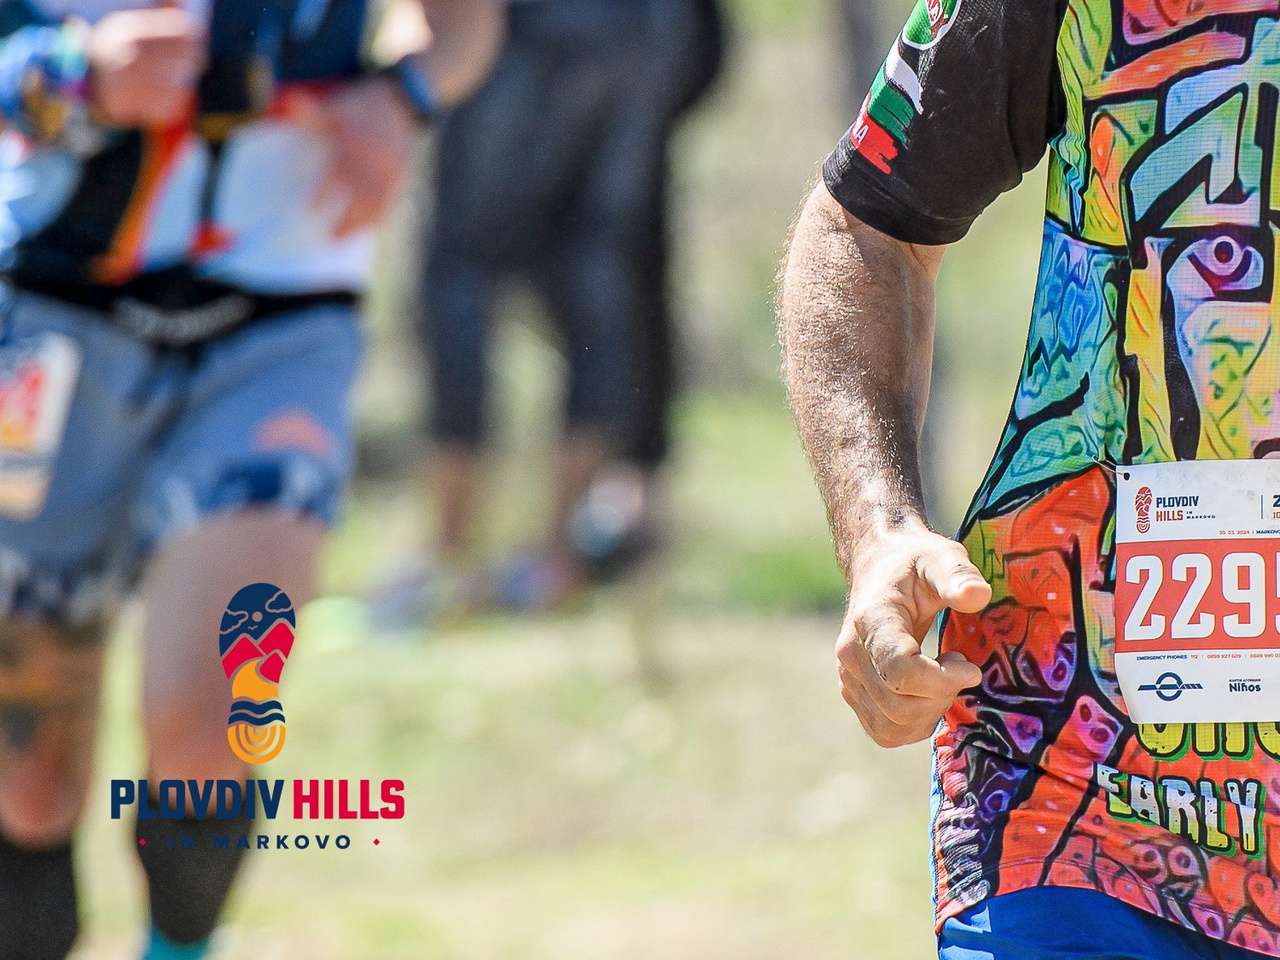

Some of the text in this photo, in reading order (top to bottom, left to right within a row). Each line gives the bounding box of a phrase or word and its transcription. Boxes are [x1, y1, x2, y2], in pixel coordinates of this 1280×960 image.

[1156, 495, 1199, 508] PLOVDIV
[1156, 510, 1184, 522] HILLS
[1094, 762, 1263, 855] EARLY
